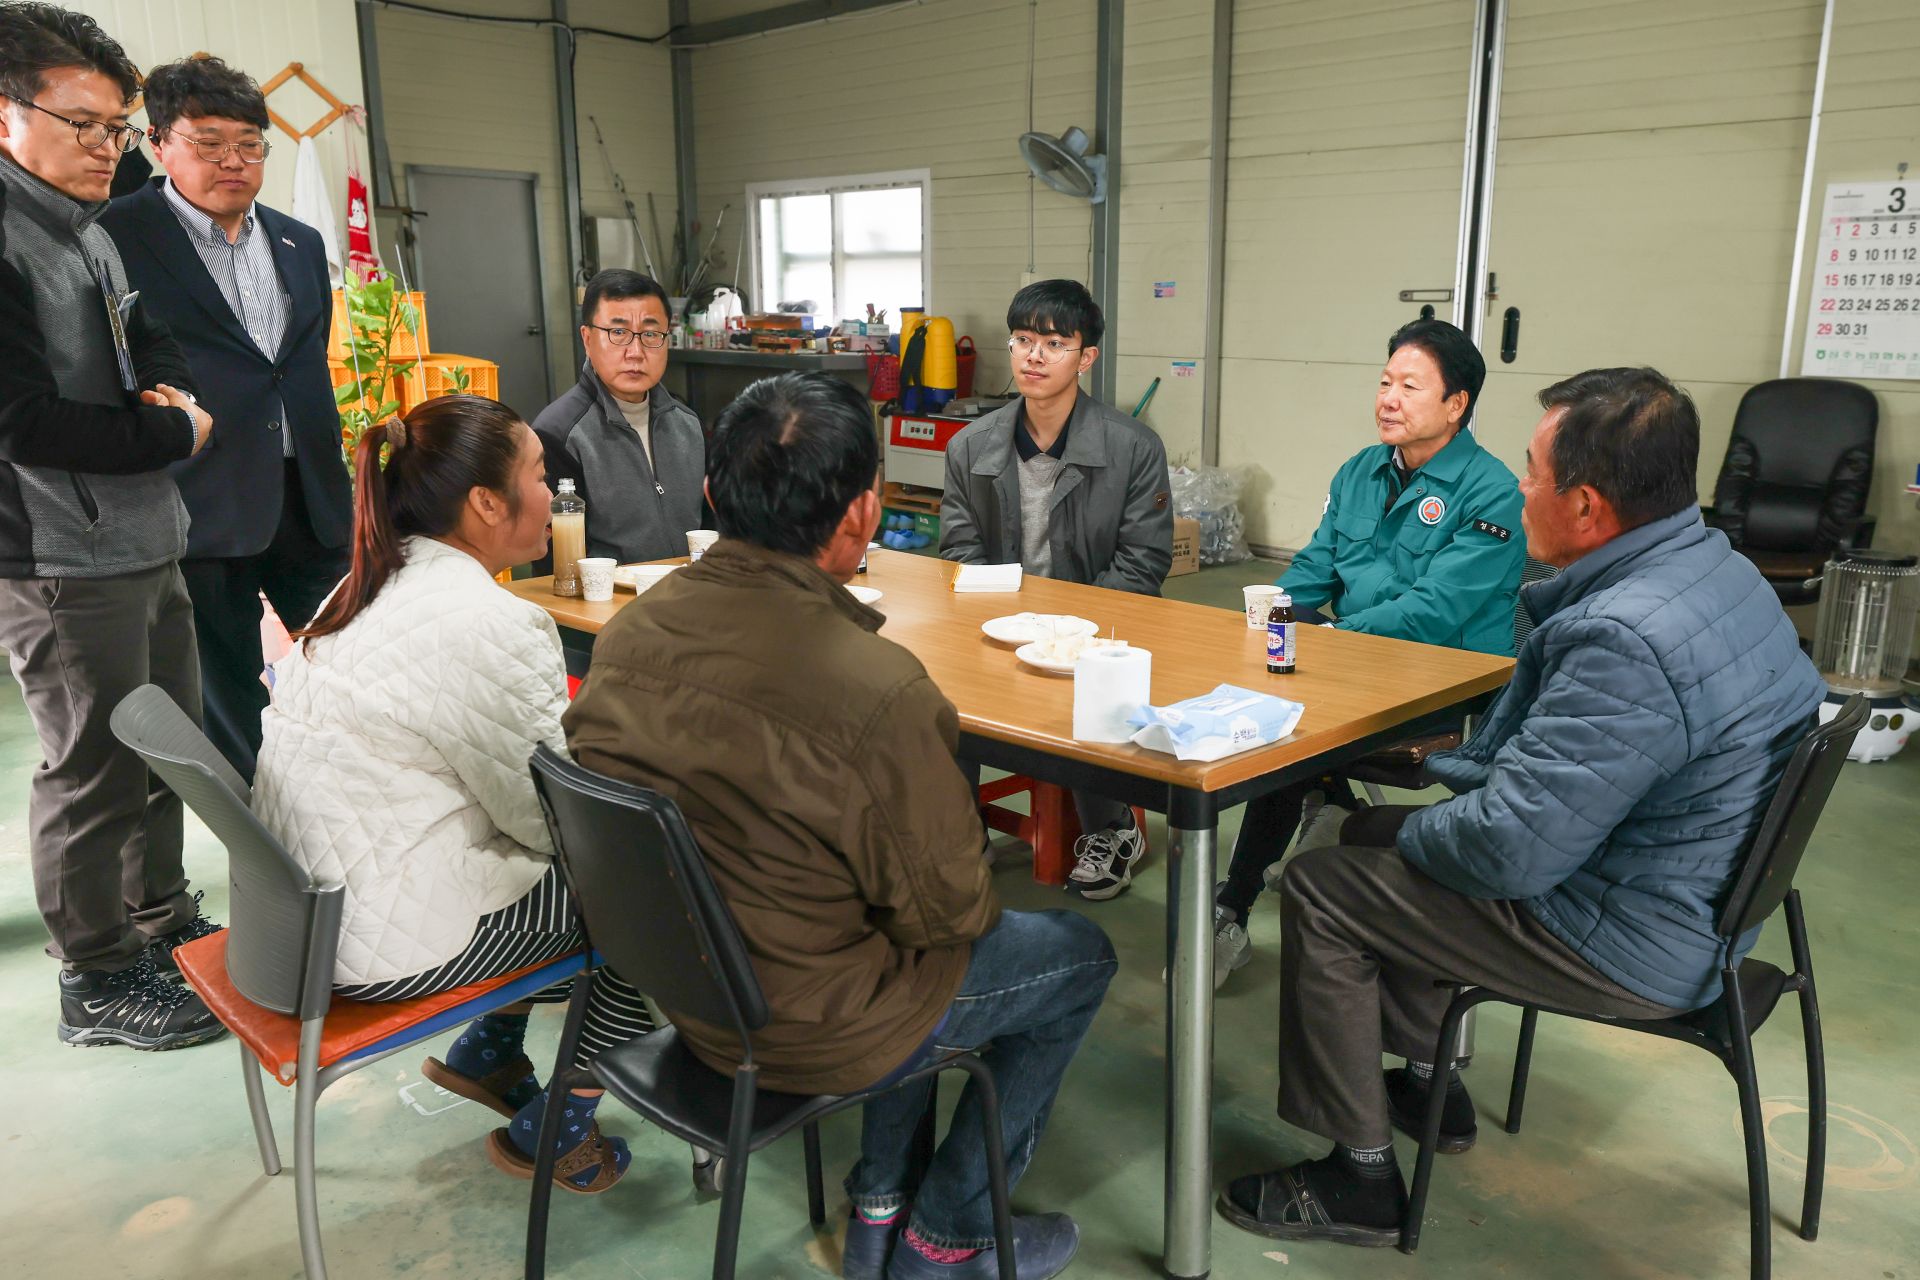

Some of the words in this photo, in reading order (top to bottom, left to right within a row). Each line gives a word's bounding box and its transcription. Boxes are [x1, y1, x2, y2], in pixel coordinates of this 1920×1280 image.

[1888, 187, 1906, 213] 3
[1835, 225, 1841, 236] 1
[1852, 224, 1860, 236] 2
[1870, 223, 1879, 235] 3
[1890, 223, 1898, 234] 4
[1908, 222, 1917, 234] 5
[1830, 250, 1839, 262] 8
[1849, 249, 1857, 261] 9
[1865, 249, 1879, 260] 10
[1884, 249, 1897, 260] 11
[1902, 248, 1917, 260] 12
[1825, 274, 1839, 286] 15
[1843, 274, 1857, 286] 16
[1861, 274, 1876, 286] 17
[1880, 274, 1894, 286] 18
[1899, 274, 1913, 285] 19
[1820, 299, 1835, 311] 22
[1838, 299, 1853, 311] 23
[1857, 299, 1872, 311] 24
[1875, 299, 1890, 311] 25
[1893, 299, 1908, 311] 26
[1911, 299, 1920, 311] 2
[1817, 323, 1832, 335] 29
[1835, 323, 1850, 335] 30
[1853, 323, 1868, 335] 31
[1480, 522, 1507, 538] 성주군
[1412, 1065, 1432, 1079] NEP
[1350, 1150, 1384, 1162] NEPA
